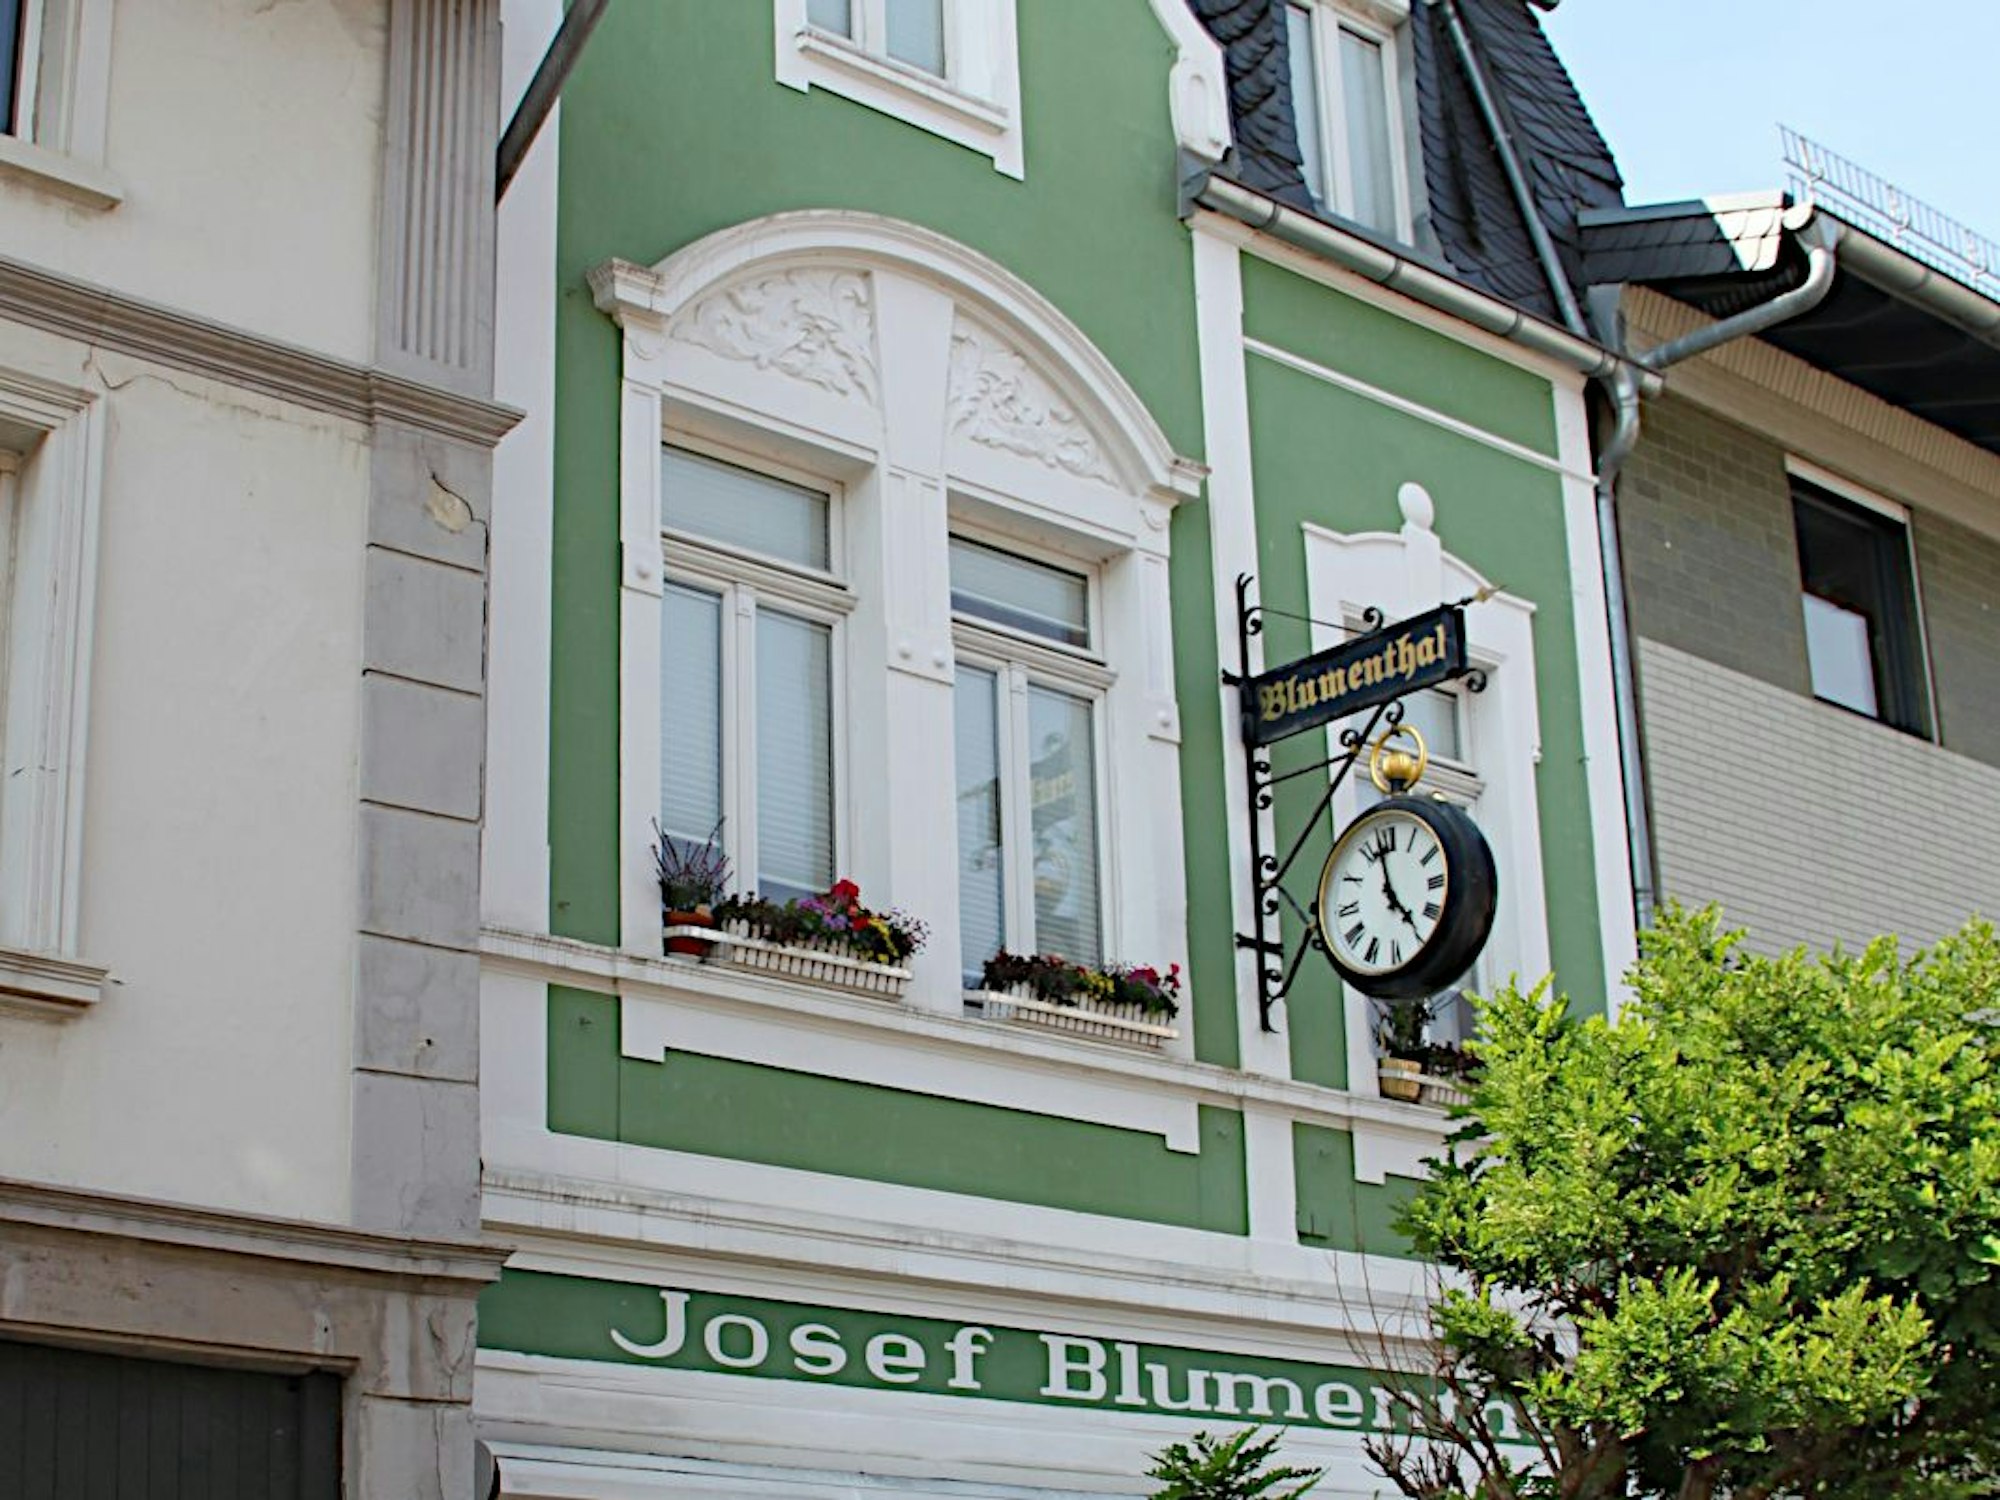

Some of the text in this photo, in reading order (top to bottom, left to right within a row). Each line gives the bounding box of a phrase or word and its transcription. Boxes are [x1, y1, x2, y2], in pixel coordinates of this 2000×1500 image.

[1259, 623, 1447, 722] Blumenthal
[610, 1290, 1553, 1442] Josef Blumenth
